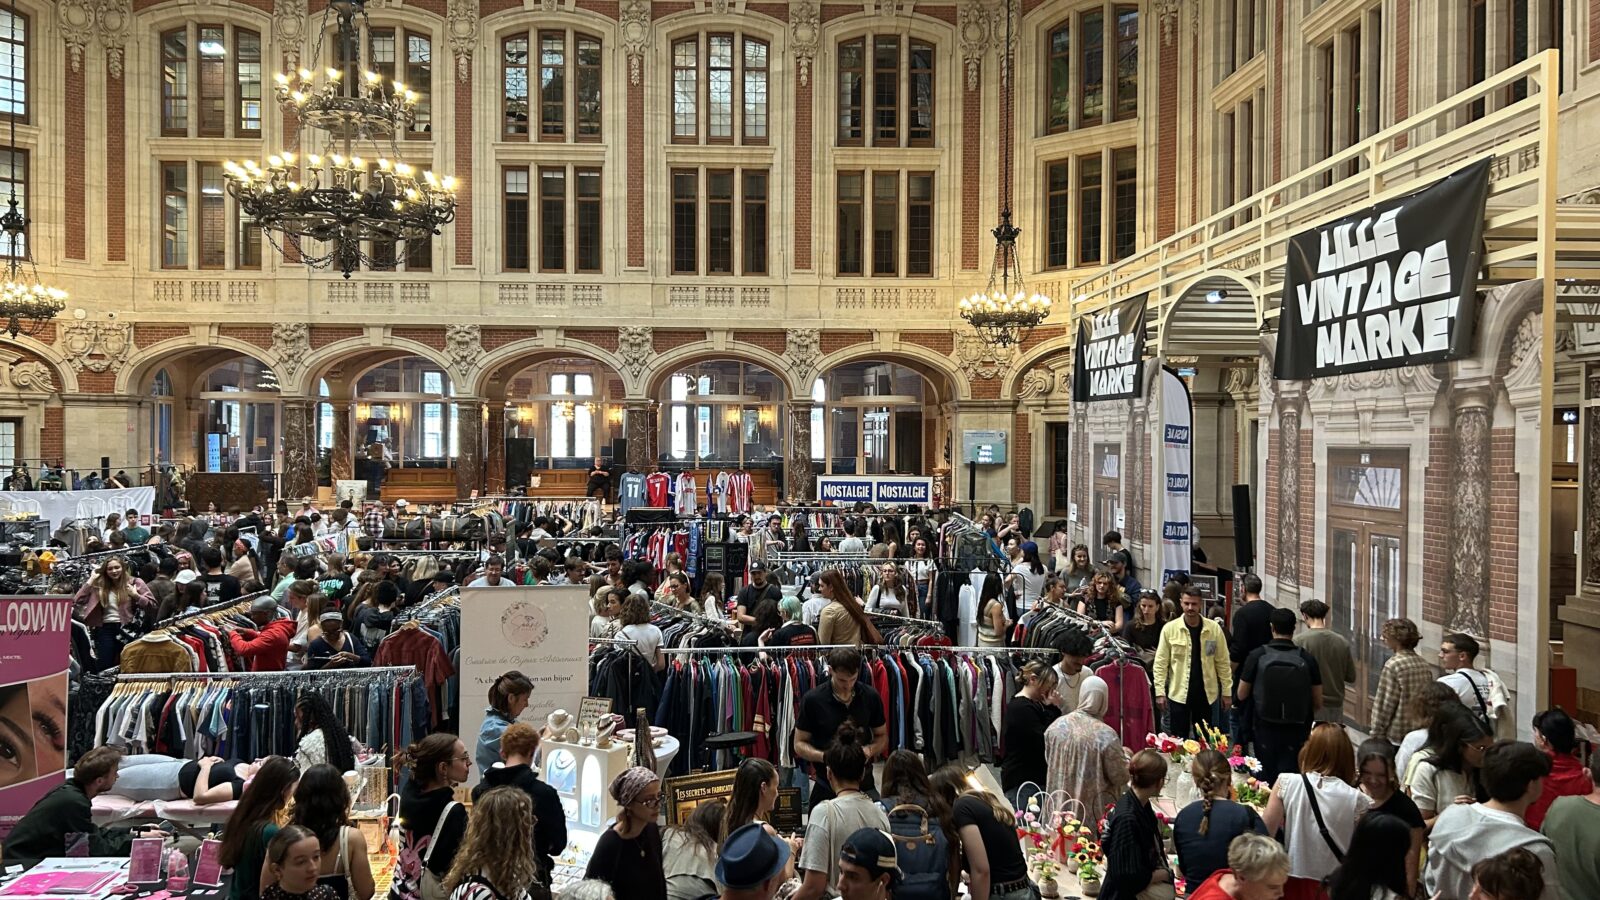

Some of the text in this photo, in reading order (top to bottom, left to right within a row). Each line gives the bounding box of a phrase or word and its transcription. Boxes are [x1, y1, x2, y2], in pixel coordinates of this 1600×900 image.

[1317, 205, 1403, 274] LILLE
[1296, 240, 1452, 326] VINTAGE
[627, 484, 639, 498] 11
[655, 482, 661, 497] 7
[823, 483, 926, 499] NOSTALGIE NOSTALGIE
[685, 787, 707, 798] SECRETS
